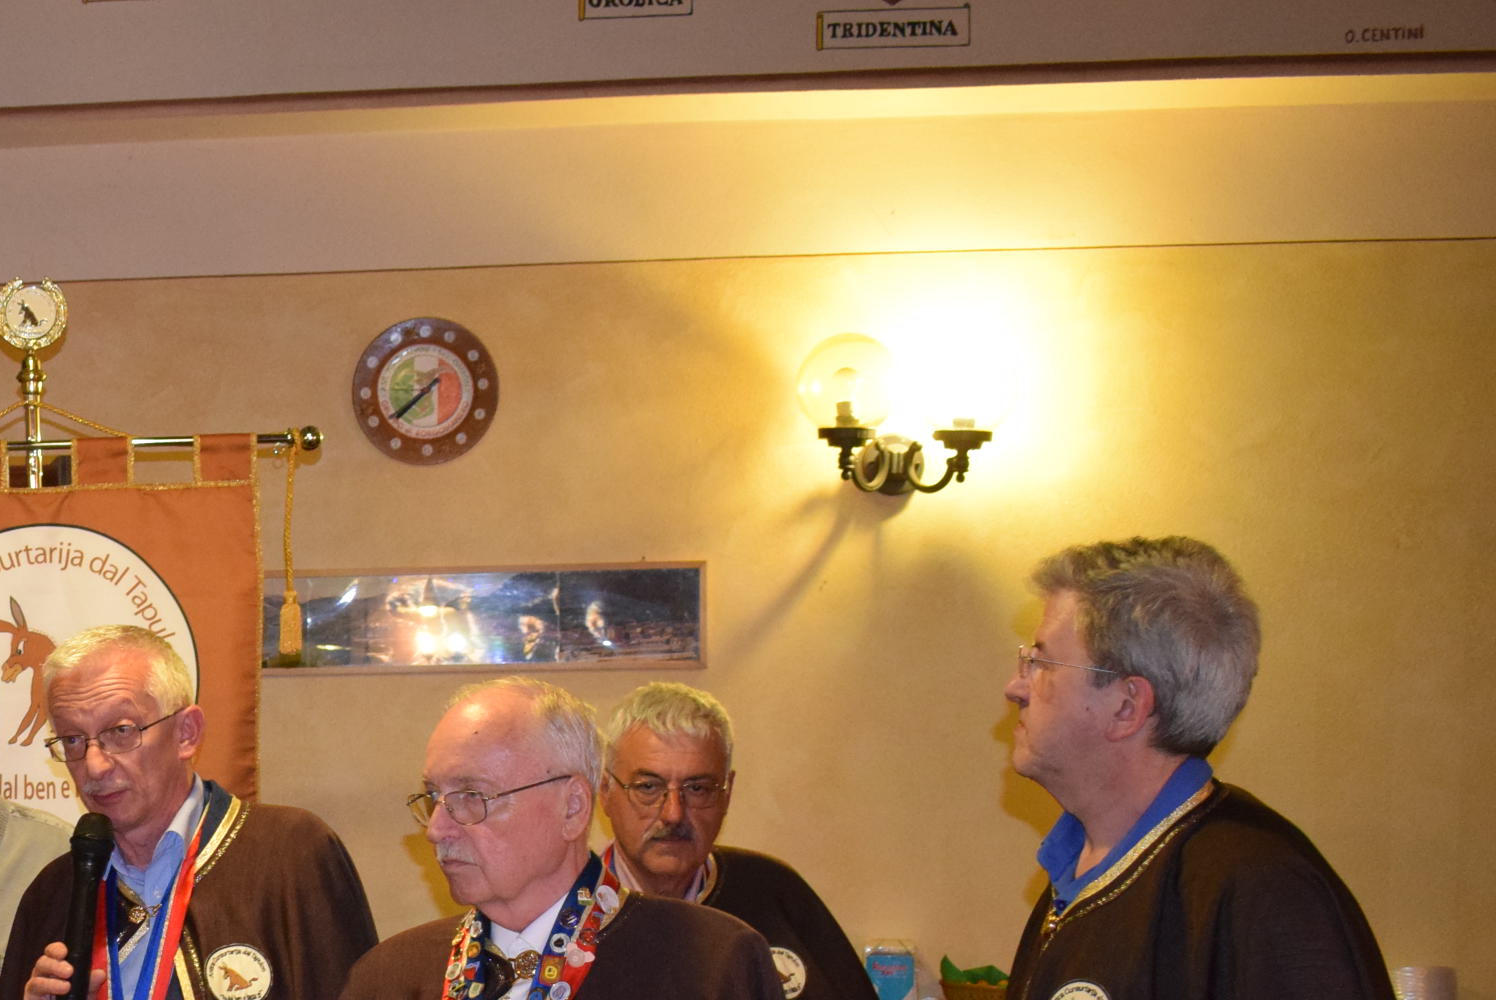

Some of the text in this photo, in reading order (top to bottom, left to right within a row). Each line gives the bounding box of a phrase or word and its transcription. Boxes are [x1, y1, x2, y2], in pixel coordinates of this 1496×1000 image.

[827, 20, 958, 39] TRIDENTINA
[89, 553, 130, 586] dal
[24, 774, 57, 800] ben
[61, 780, 70, 799] e
